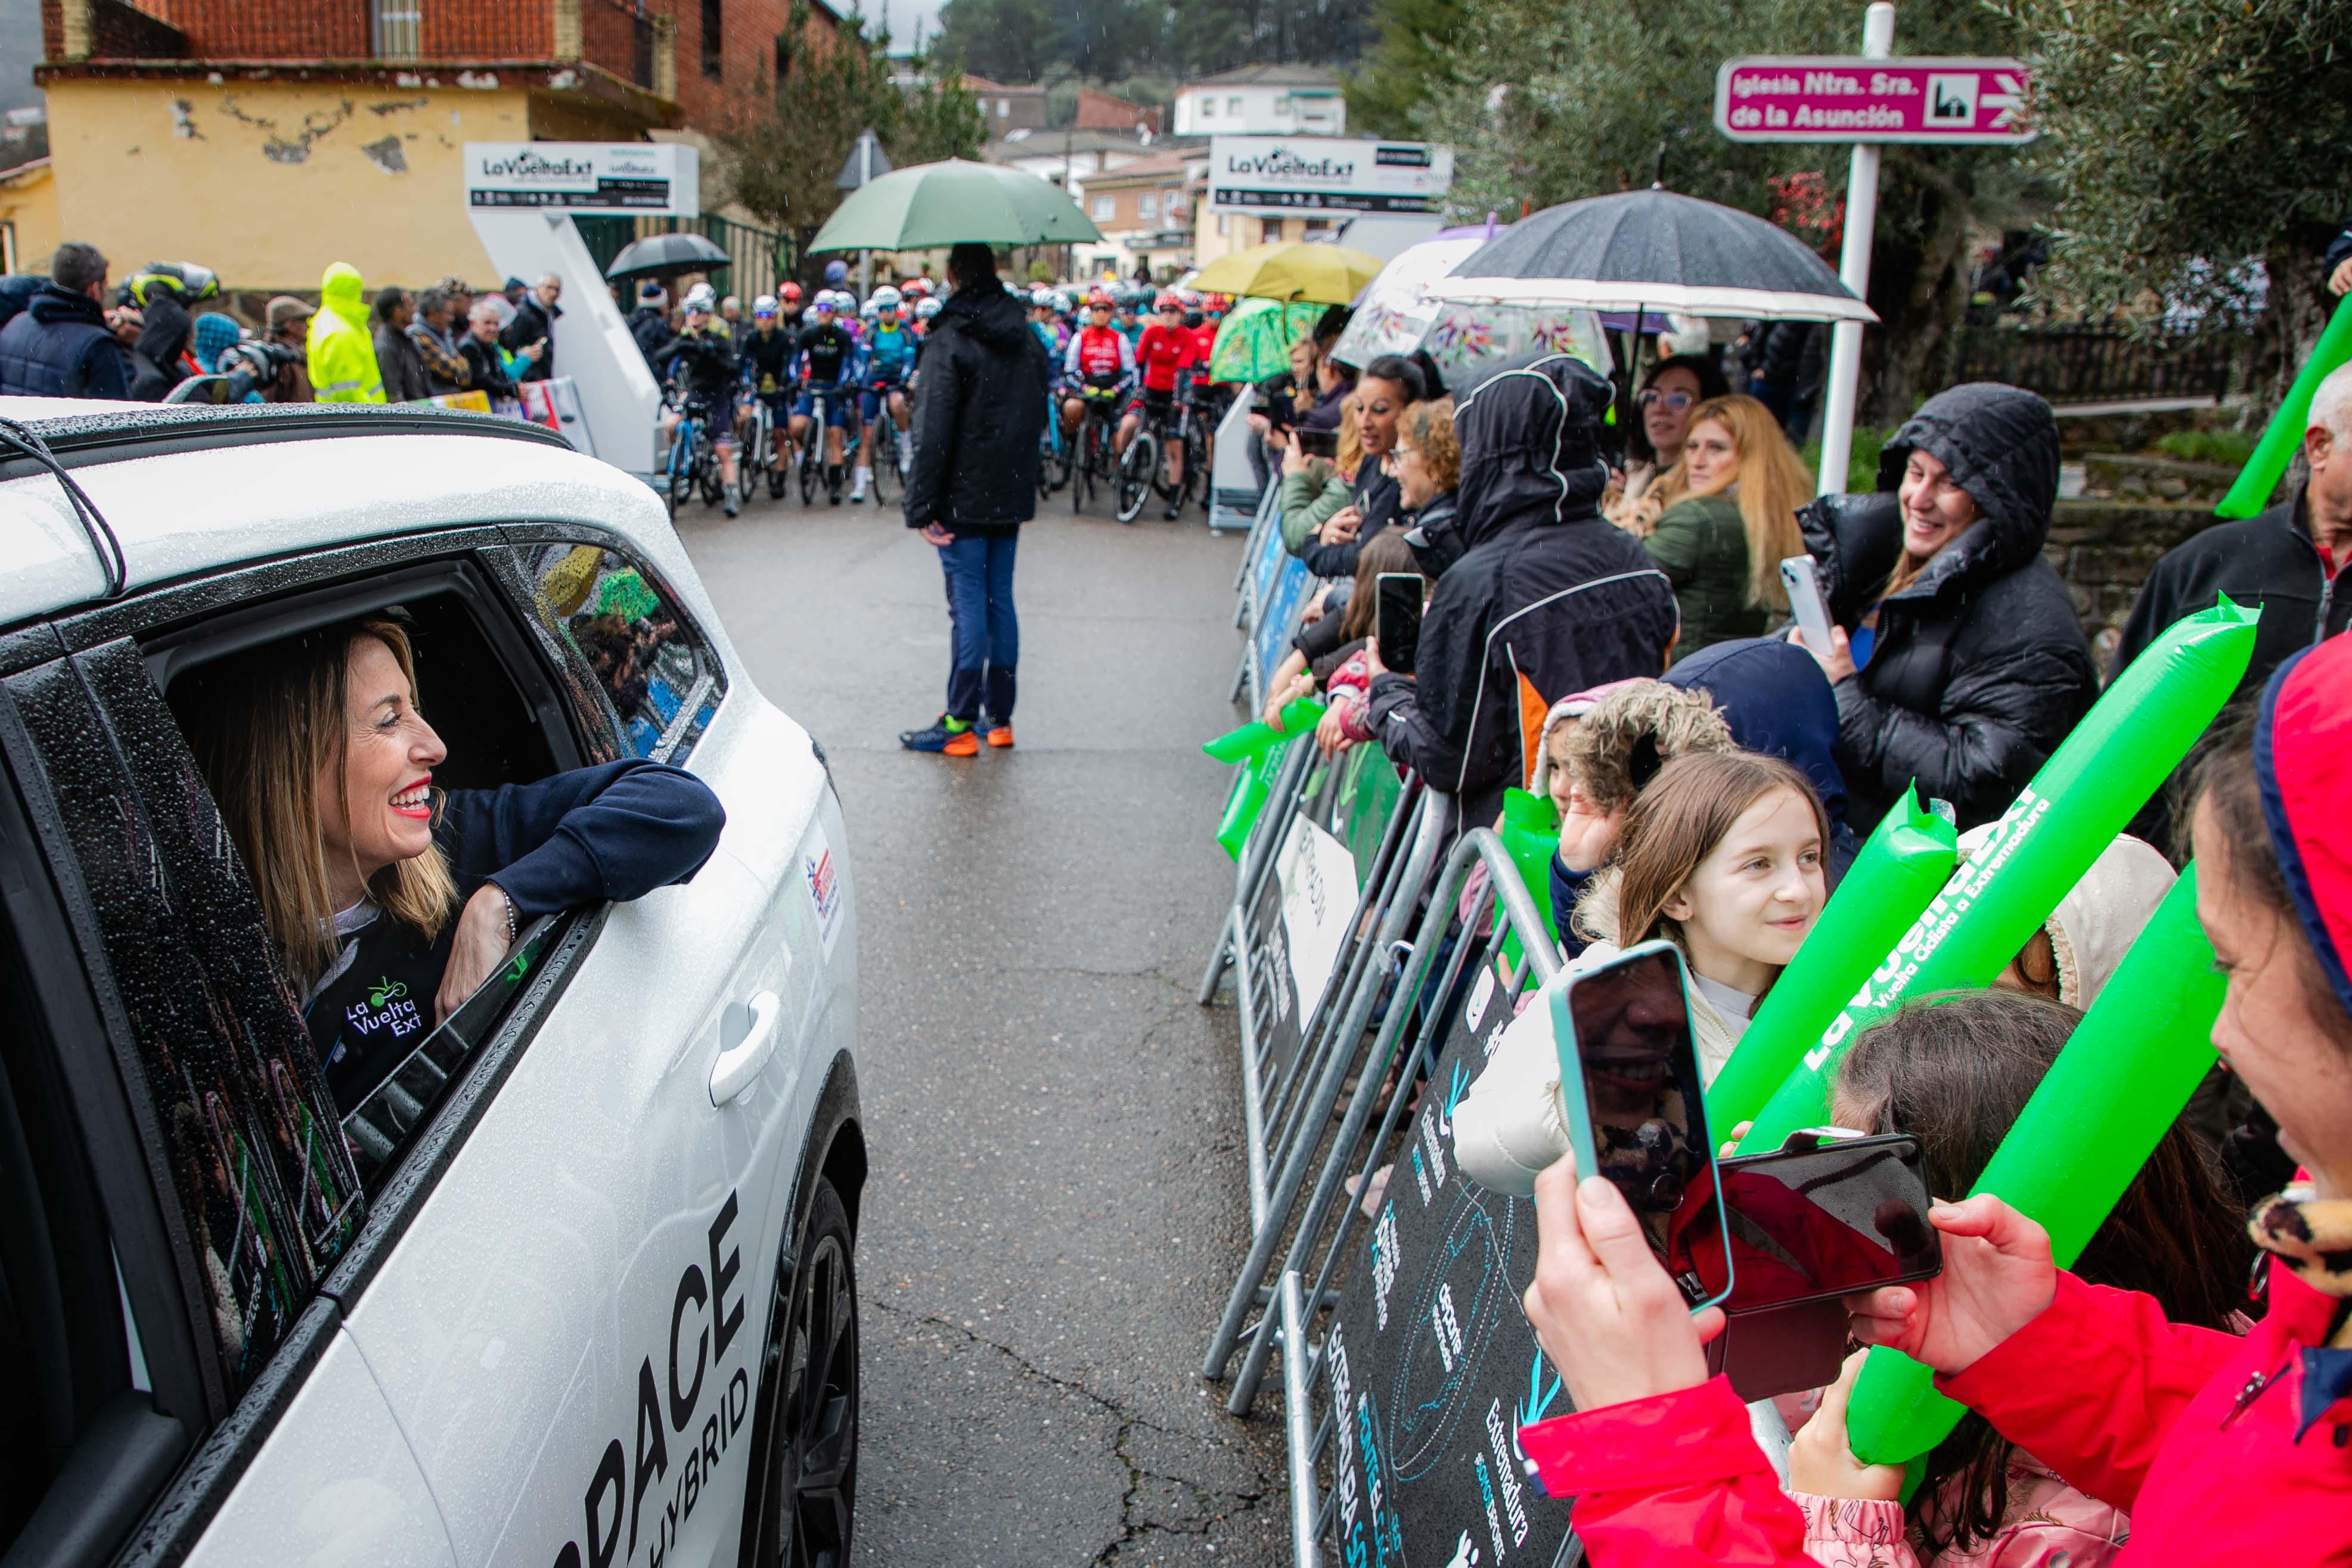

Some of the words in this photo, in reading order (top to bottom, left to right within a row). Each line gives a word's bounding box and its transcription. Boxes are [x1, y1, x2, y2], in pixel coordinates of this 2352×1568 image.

[1804, 72, 1866, 95] Ntra.
[1869, 72, 1920, 95] Sra.
[1730, 104, 1763, 127] de
[1765, 103, 1789, 127] la
[1792, 103, 1904, 128] Asunción
[1872, 965, 1918, 1010] Vuelta
[1955, 899, 1970, 913] a
[1967, 797, 2050, 899] Extremadura
[345, 1001, 369, 1021] La
[353, 999, 417, 1036] Vuelta
[389, 1013, 422, 1038] Ext
[1438, 1281, 1462, 1356] deporte
[1327, 1321, 1359, 1540] EXTREMADURA
[649, 1367, 749, 1568] HYBRID
[1485, 1396, 1528, 1548] Extremadura
